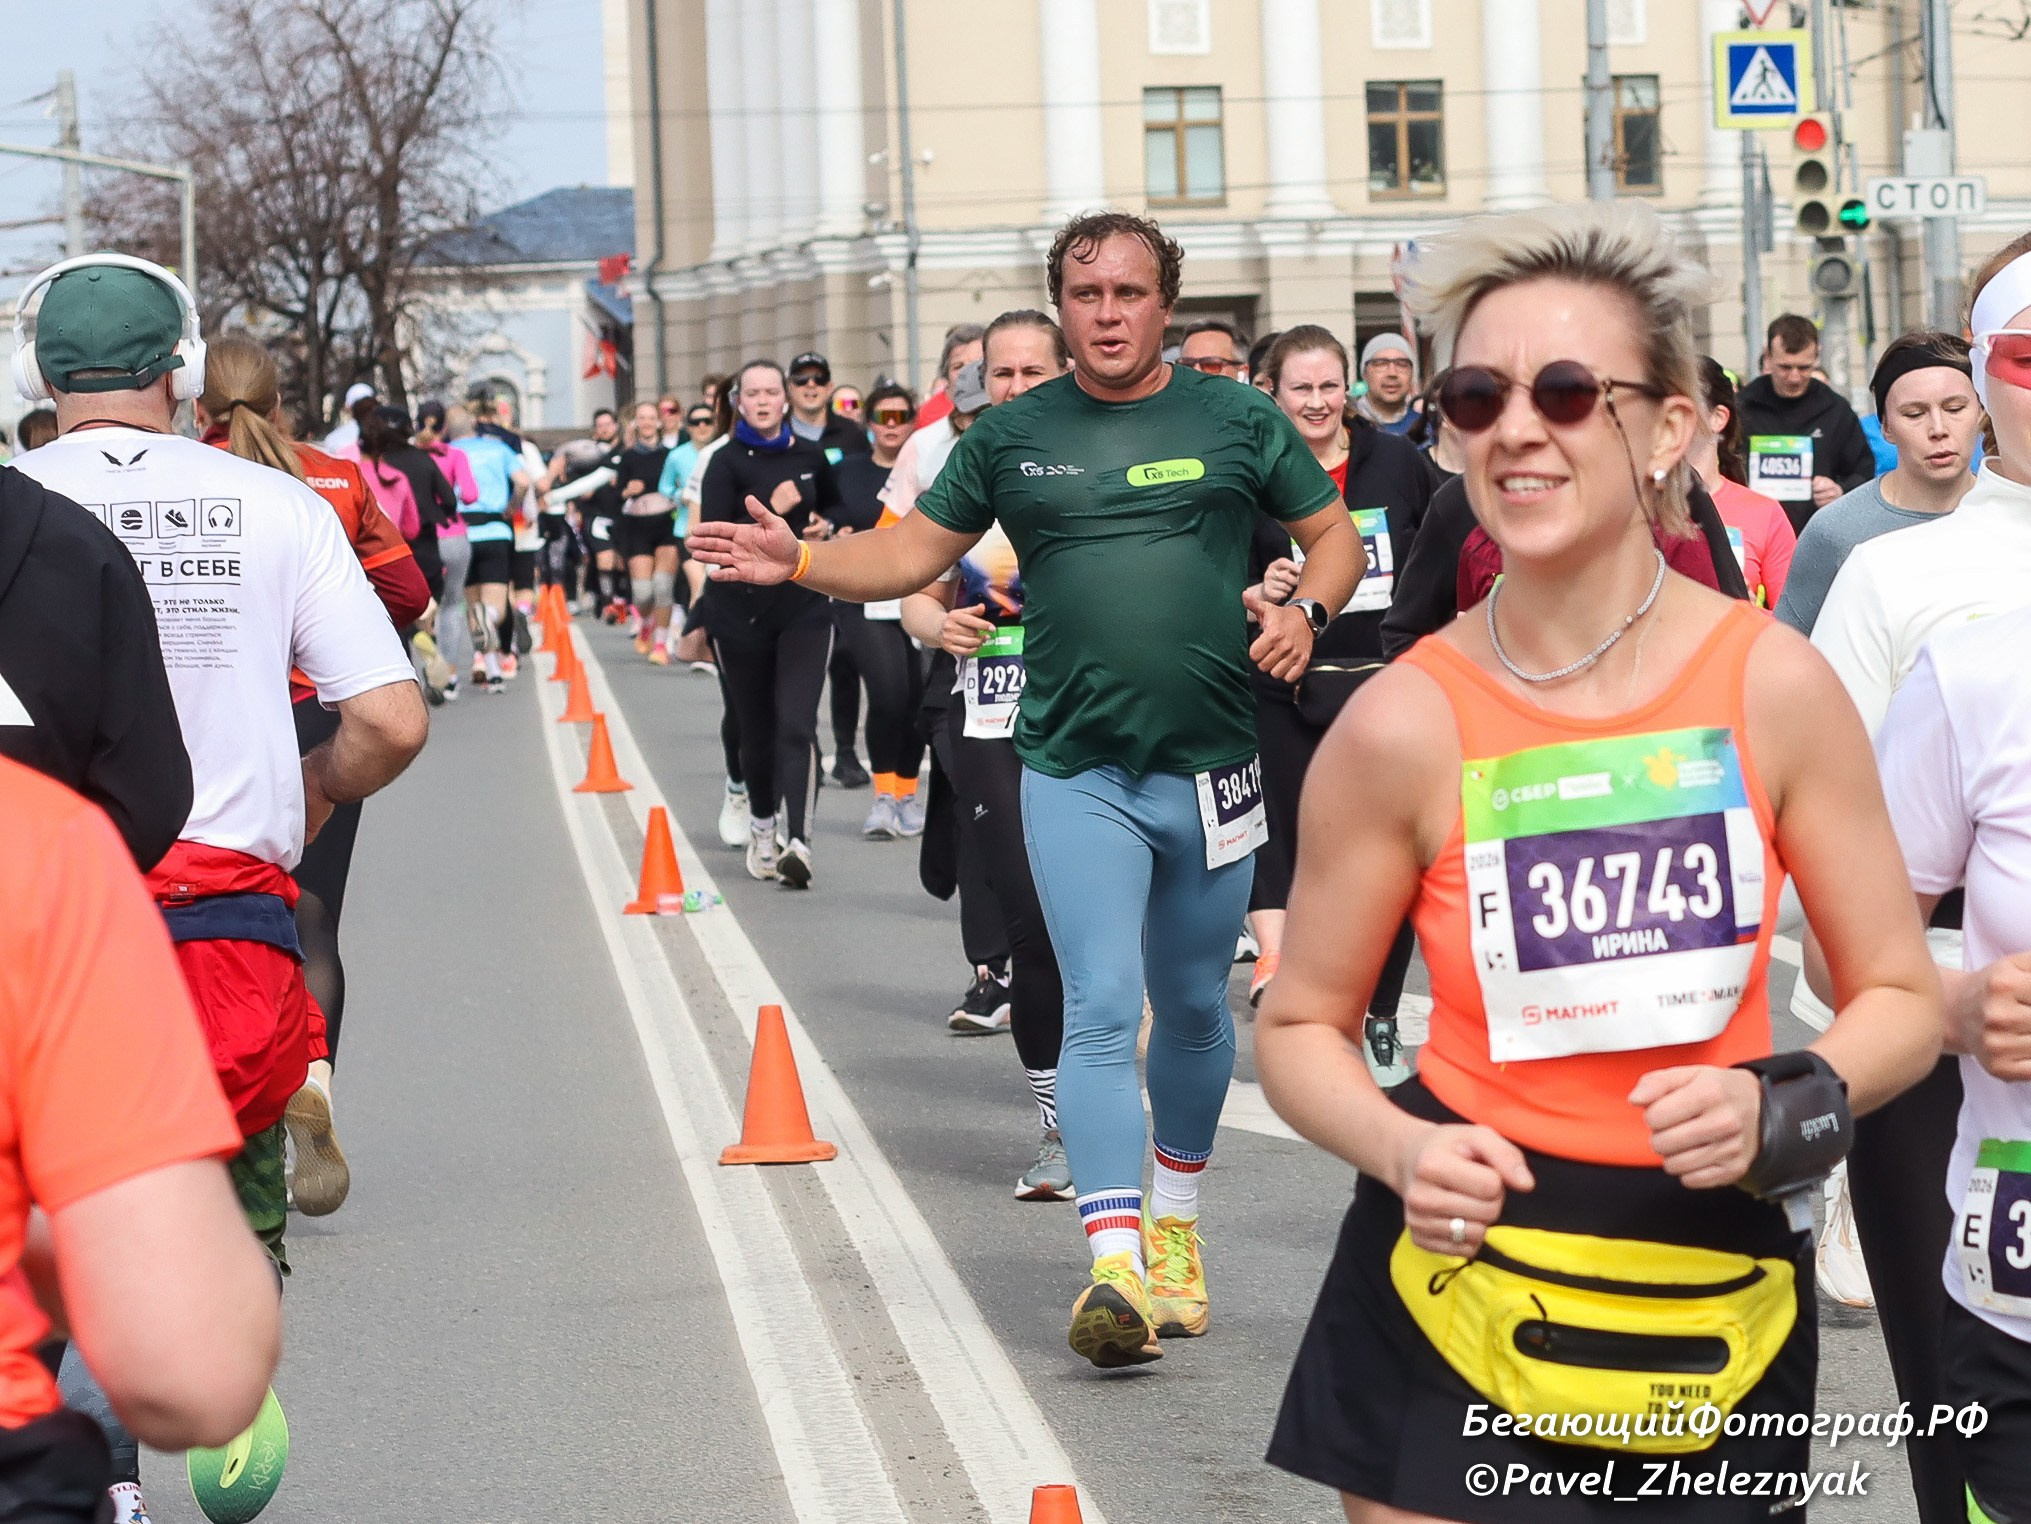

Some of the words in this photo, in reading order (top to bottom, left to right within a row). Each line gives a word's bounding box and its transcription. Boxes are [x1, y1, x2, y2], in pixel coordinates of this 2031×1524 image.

[1876, 183, 1976, 210] СТОП
[1166, 468, 1190, 478] Tech
[161, 560, 173, 577] В
[180, 560, 241, 577] СЕБЕ
[192, 598, 225, 606] ТОЛЬКО
[967, 677, 976, 690] D
[1479, 891, 1498, 929] F
[1527, 842, 1724, 940] 36743
[1591, 927, 1669, 960] ИРИНА
[1545, 1001, 1620, 1020] МАГНИТ
[1963, 1214, 1982, 1249] E
[1650, 1384, 1675, 1397] YOU
[1679, 1385, 1711, 1399] NEED
